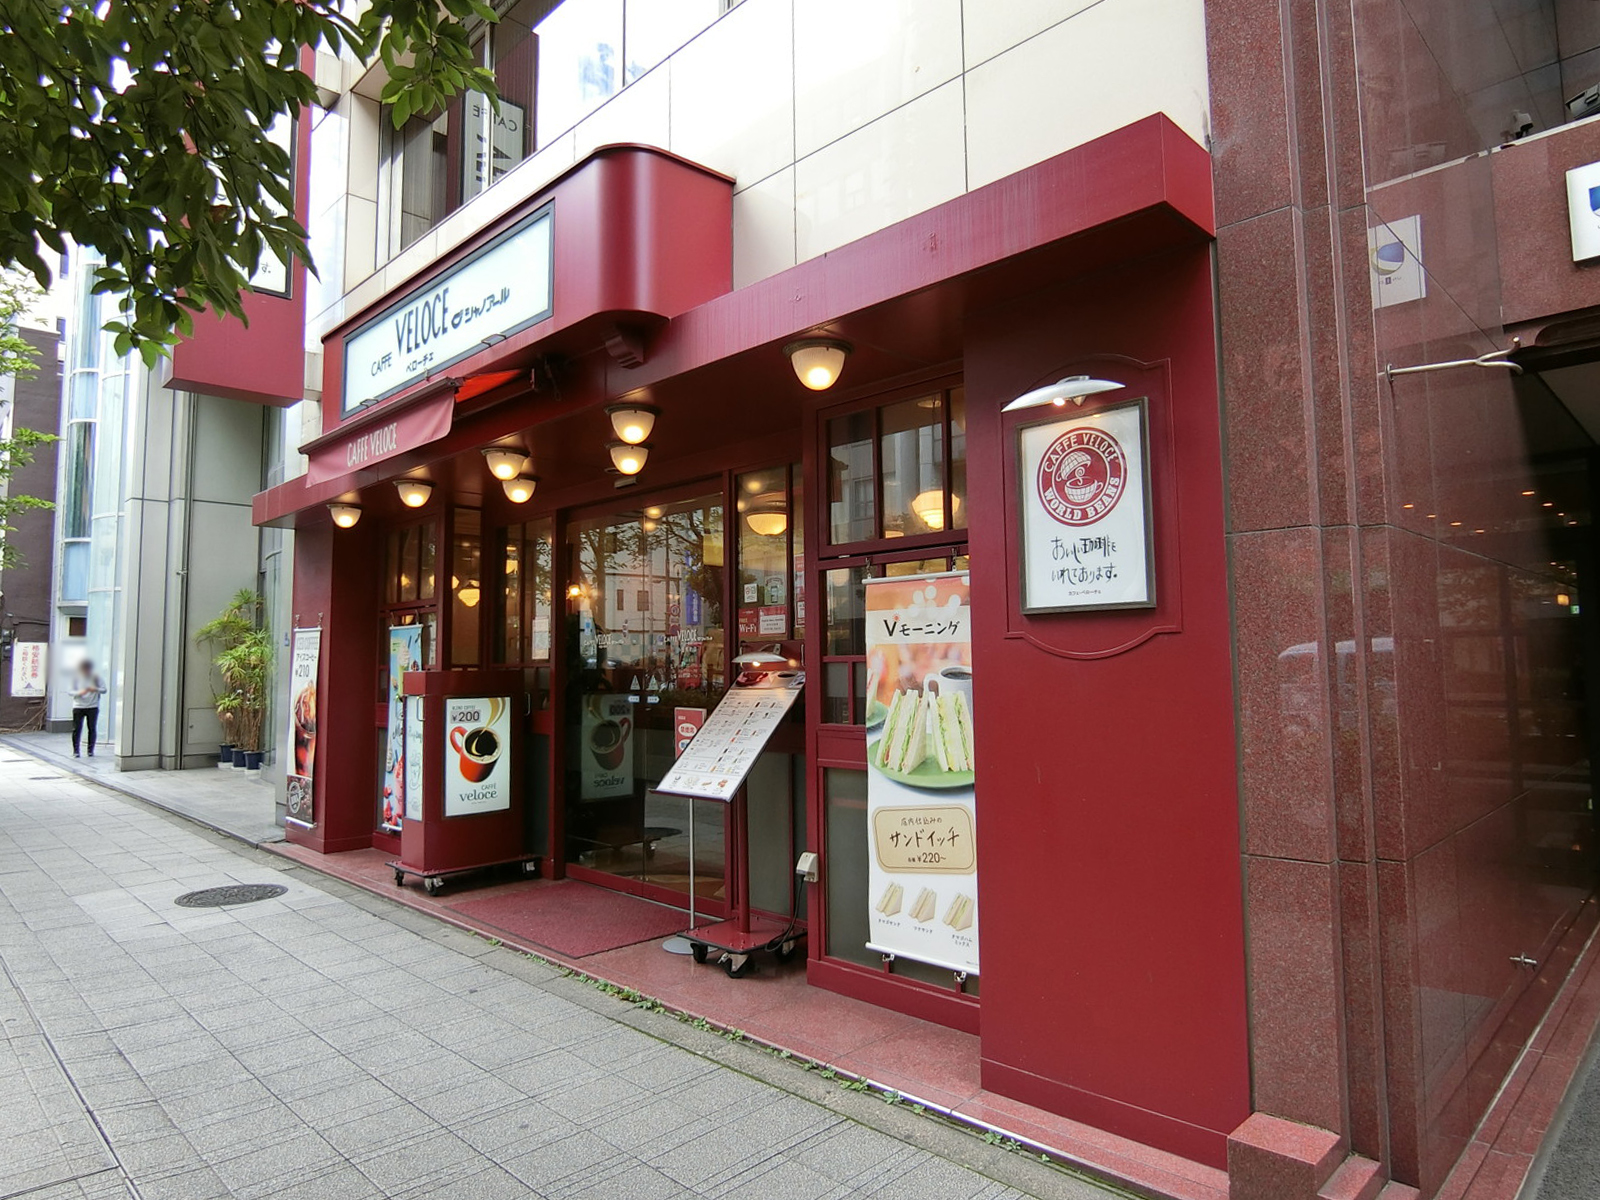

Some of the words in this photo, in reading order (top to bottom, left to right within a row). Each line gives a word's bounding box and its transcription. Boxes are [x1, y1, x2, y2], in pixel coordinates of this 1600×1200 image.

[371, 352, 392, 376] CAFFE
[395, 287, 449, 355] VELOCE
[464, 286, 510, 323] シャノアール
[369, 422, 397, 457] VELOCE
[1044, 435, 1078, 472] CAFFE
[1082, 433, 1117, 461] VELOCE
[1044, 486, 1081, 519] WORLD
[1085, 477, 1119, 518] BEANS
[1051, 562, 1117, 585] いれております。
[739, 624, 757, 633] Wi-Fi
[452, 711, 480, 722] ¥200
[459, 789, 498, 802] veloce
[889, 826, 960, 848] サンドイッチ
